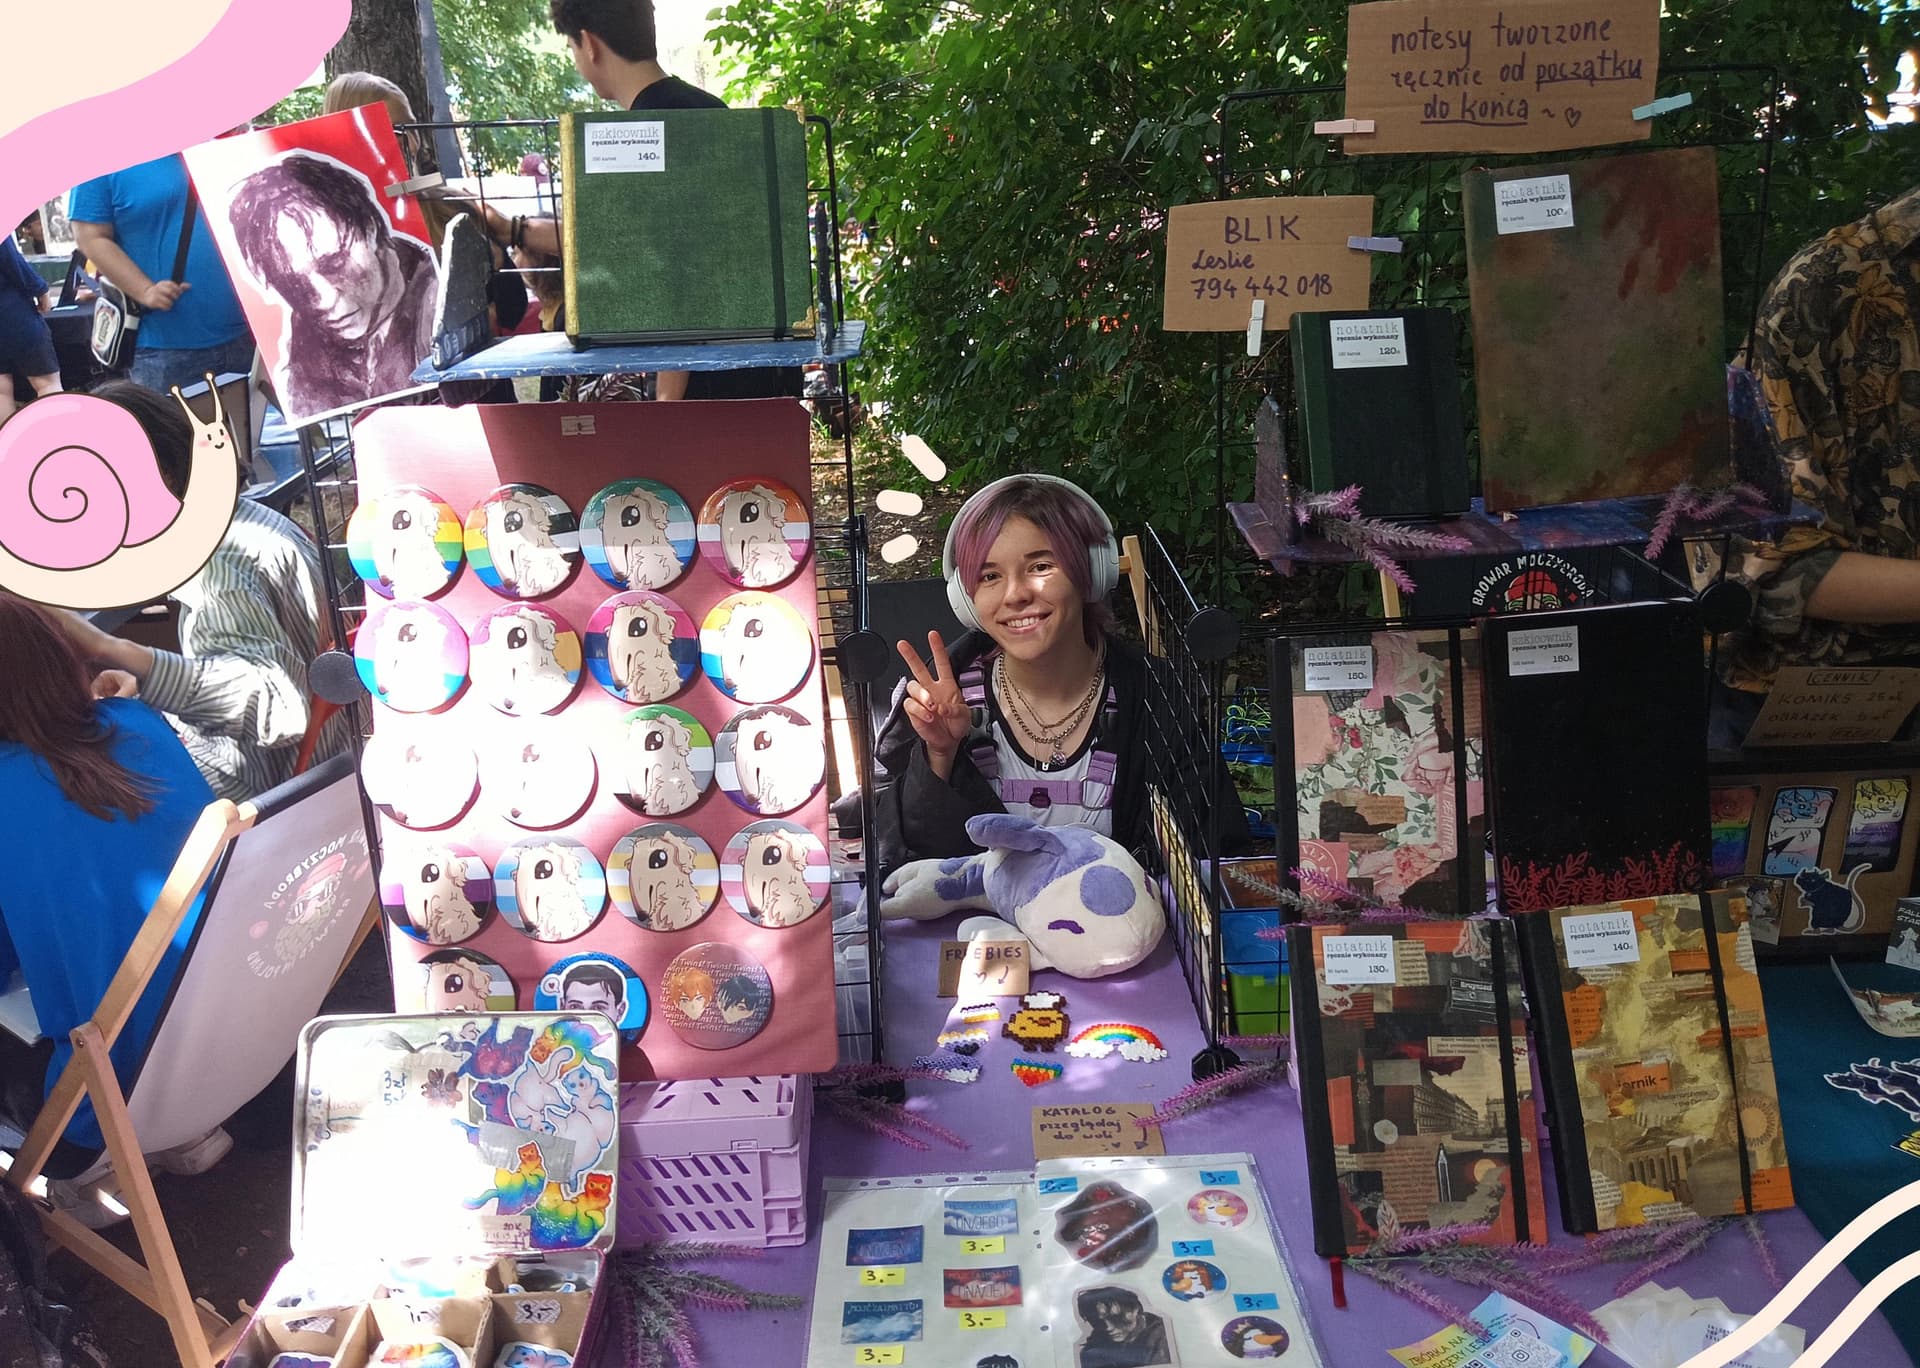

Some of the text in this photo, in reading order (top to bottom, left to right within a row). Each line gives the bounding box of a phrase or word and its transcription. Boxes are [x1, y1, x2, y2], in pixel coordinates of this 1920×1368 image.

[1391, 11, 1612, 67] notesy tworzone
[1391, 50, 1642, 92] ręcznie od początku
[1423, 92, 1529, 121] do końca
[592, 127, 659, 139] szkicownik
[1501, 181, 1566, 199] notatnik
[1225, 215, 1301, 244] BLIK
[1191, 250, 1255, 269] Leslie
[1191, 273, 1332, 300] 794 442 018
[1337, 322, 1399, 335] notatnik
[1472, 562, 1513, 606] BROWAR
[1309, 648, 1367, 661] notatnik
[1570, 918, 1629, 933] notatnik
[1327, 940, 1387, 952] notatnik
[1042, 1106, 1116, 1117] KATALOG
[1040, 1119, 1121, 1133] przeglądaj
[1054, 1130, 1112, 1140] do woli
[1447, 1336, 1467, 1348] NA
